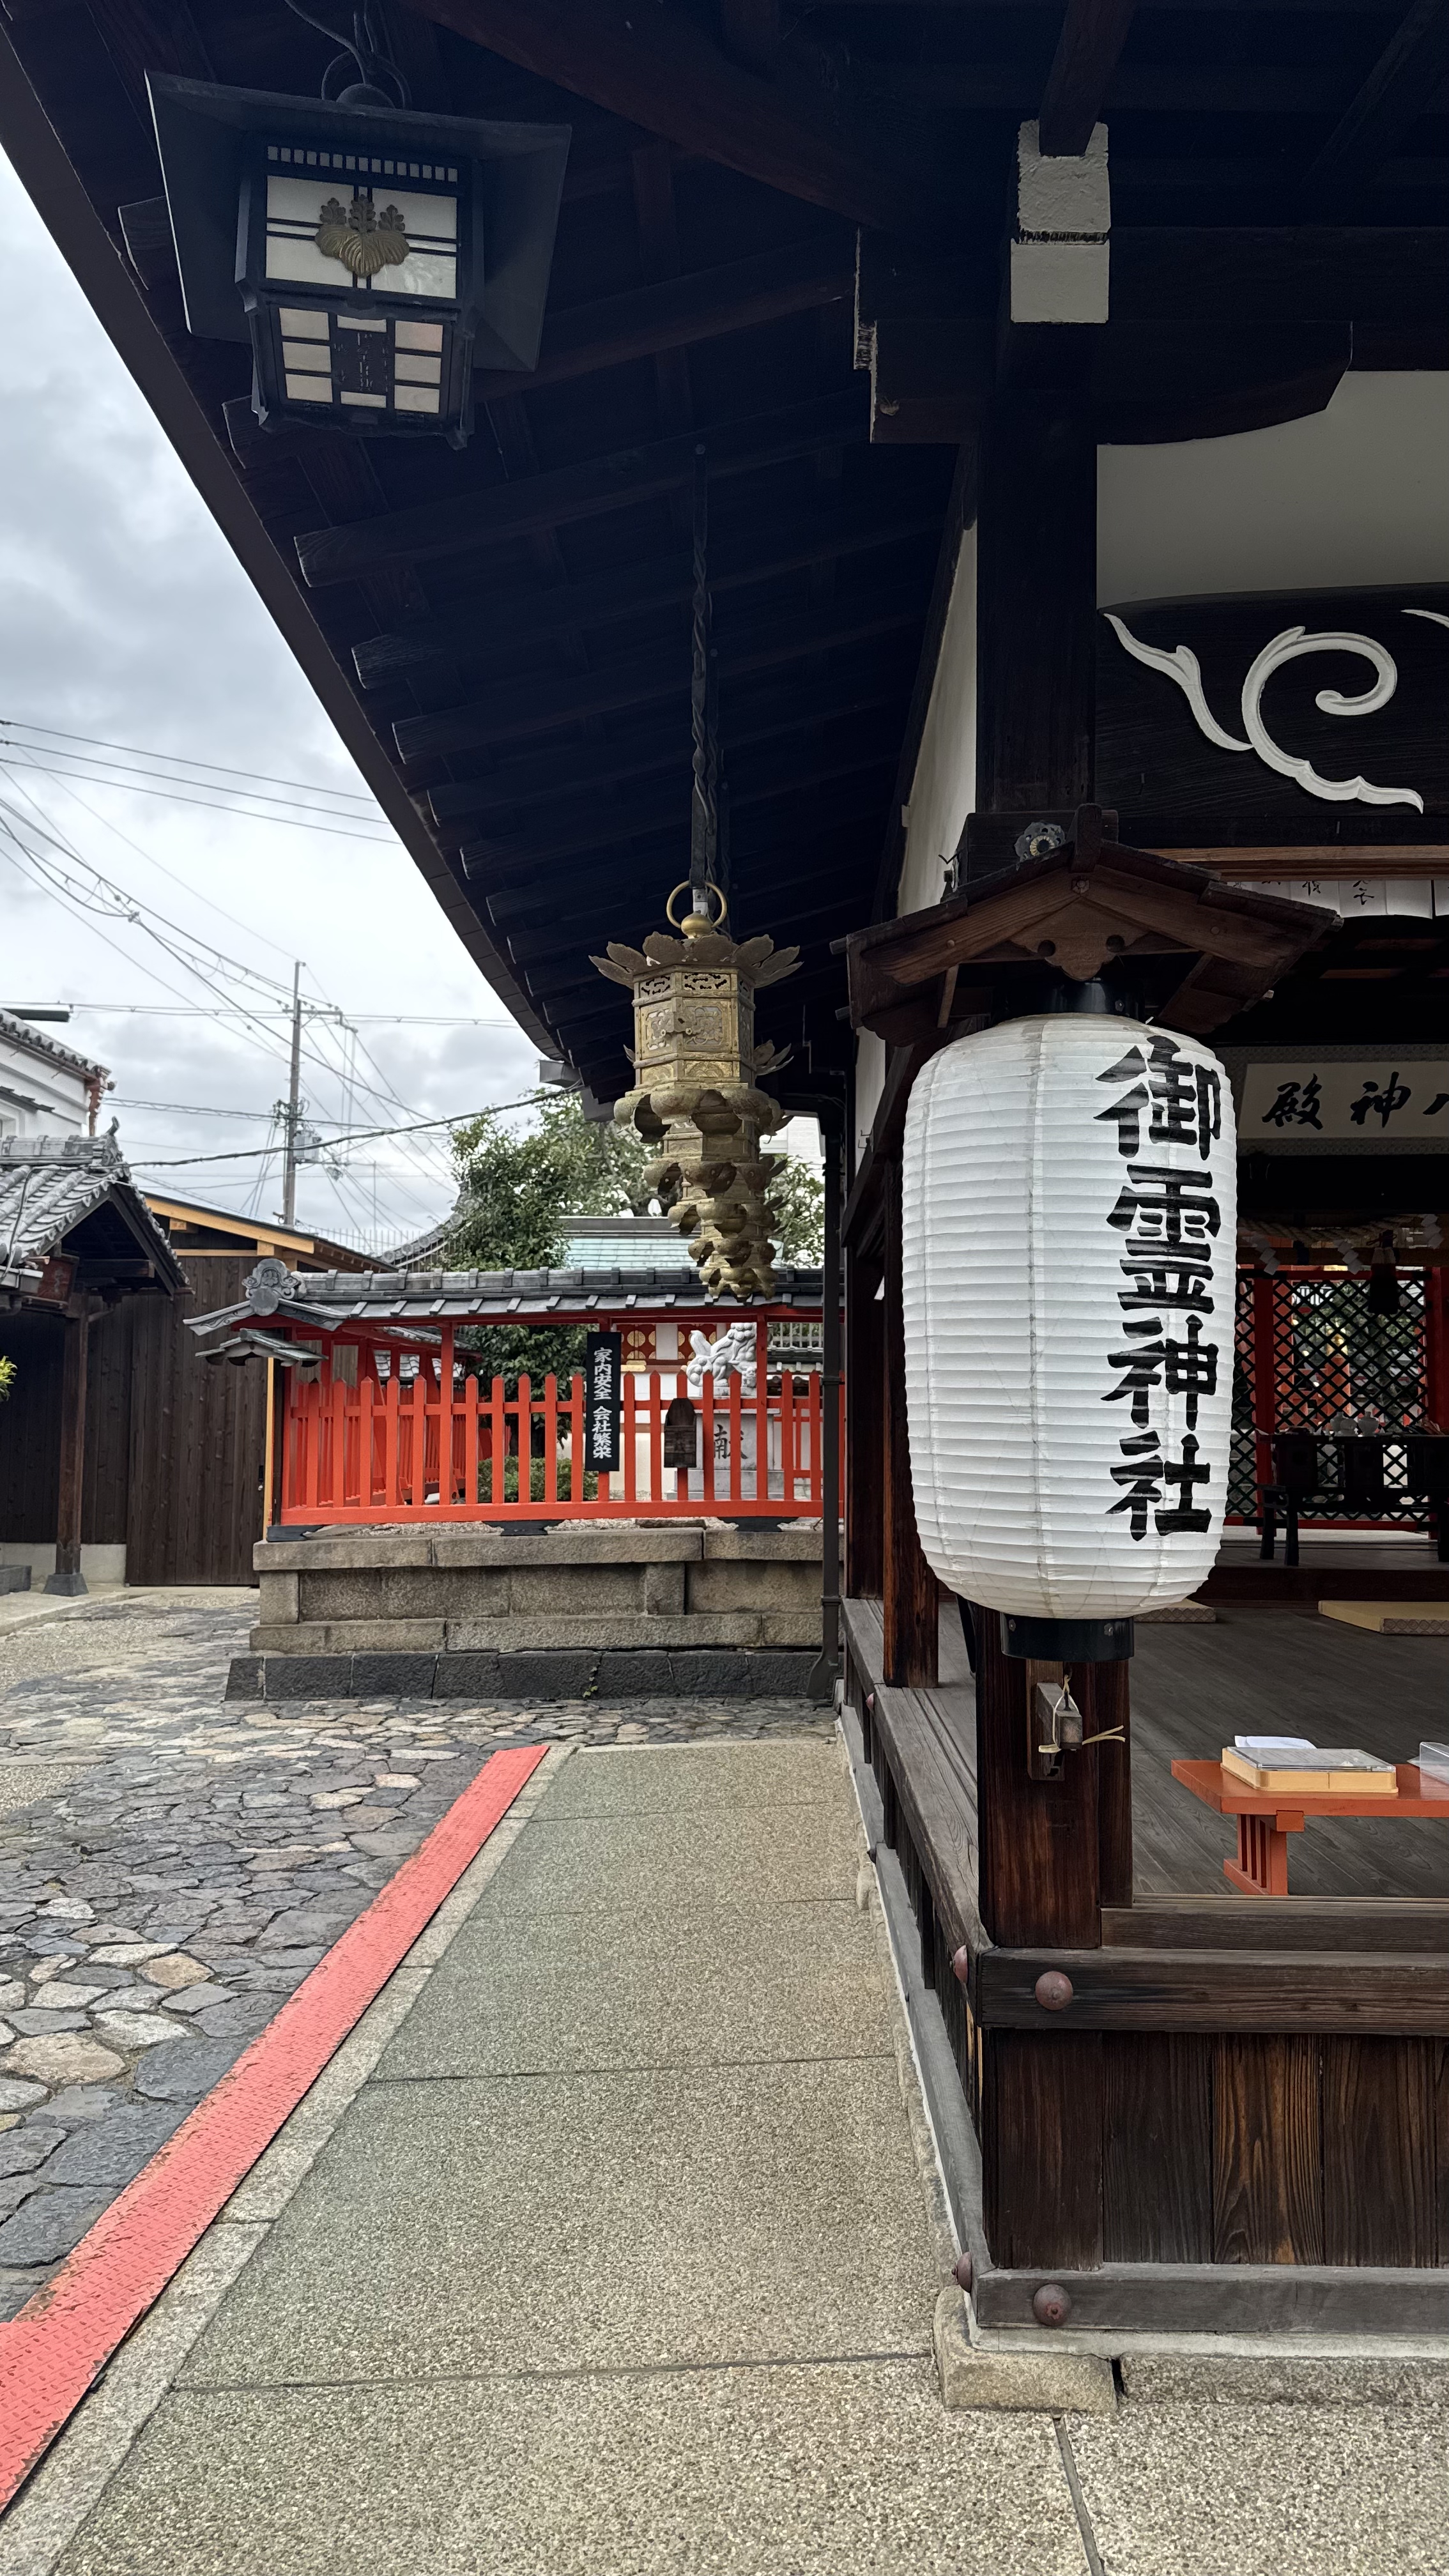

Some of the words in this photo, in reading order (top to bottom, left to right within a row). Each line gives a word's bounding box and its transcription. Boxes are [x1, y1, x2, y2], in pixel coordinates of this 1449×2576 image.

[1094, 1036, 1221, 1542] 御霊神社
[594, 1347, 613, 1400] 家内安全
[592, 1406, 613, 1459] 会社繁栄
